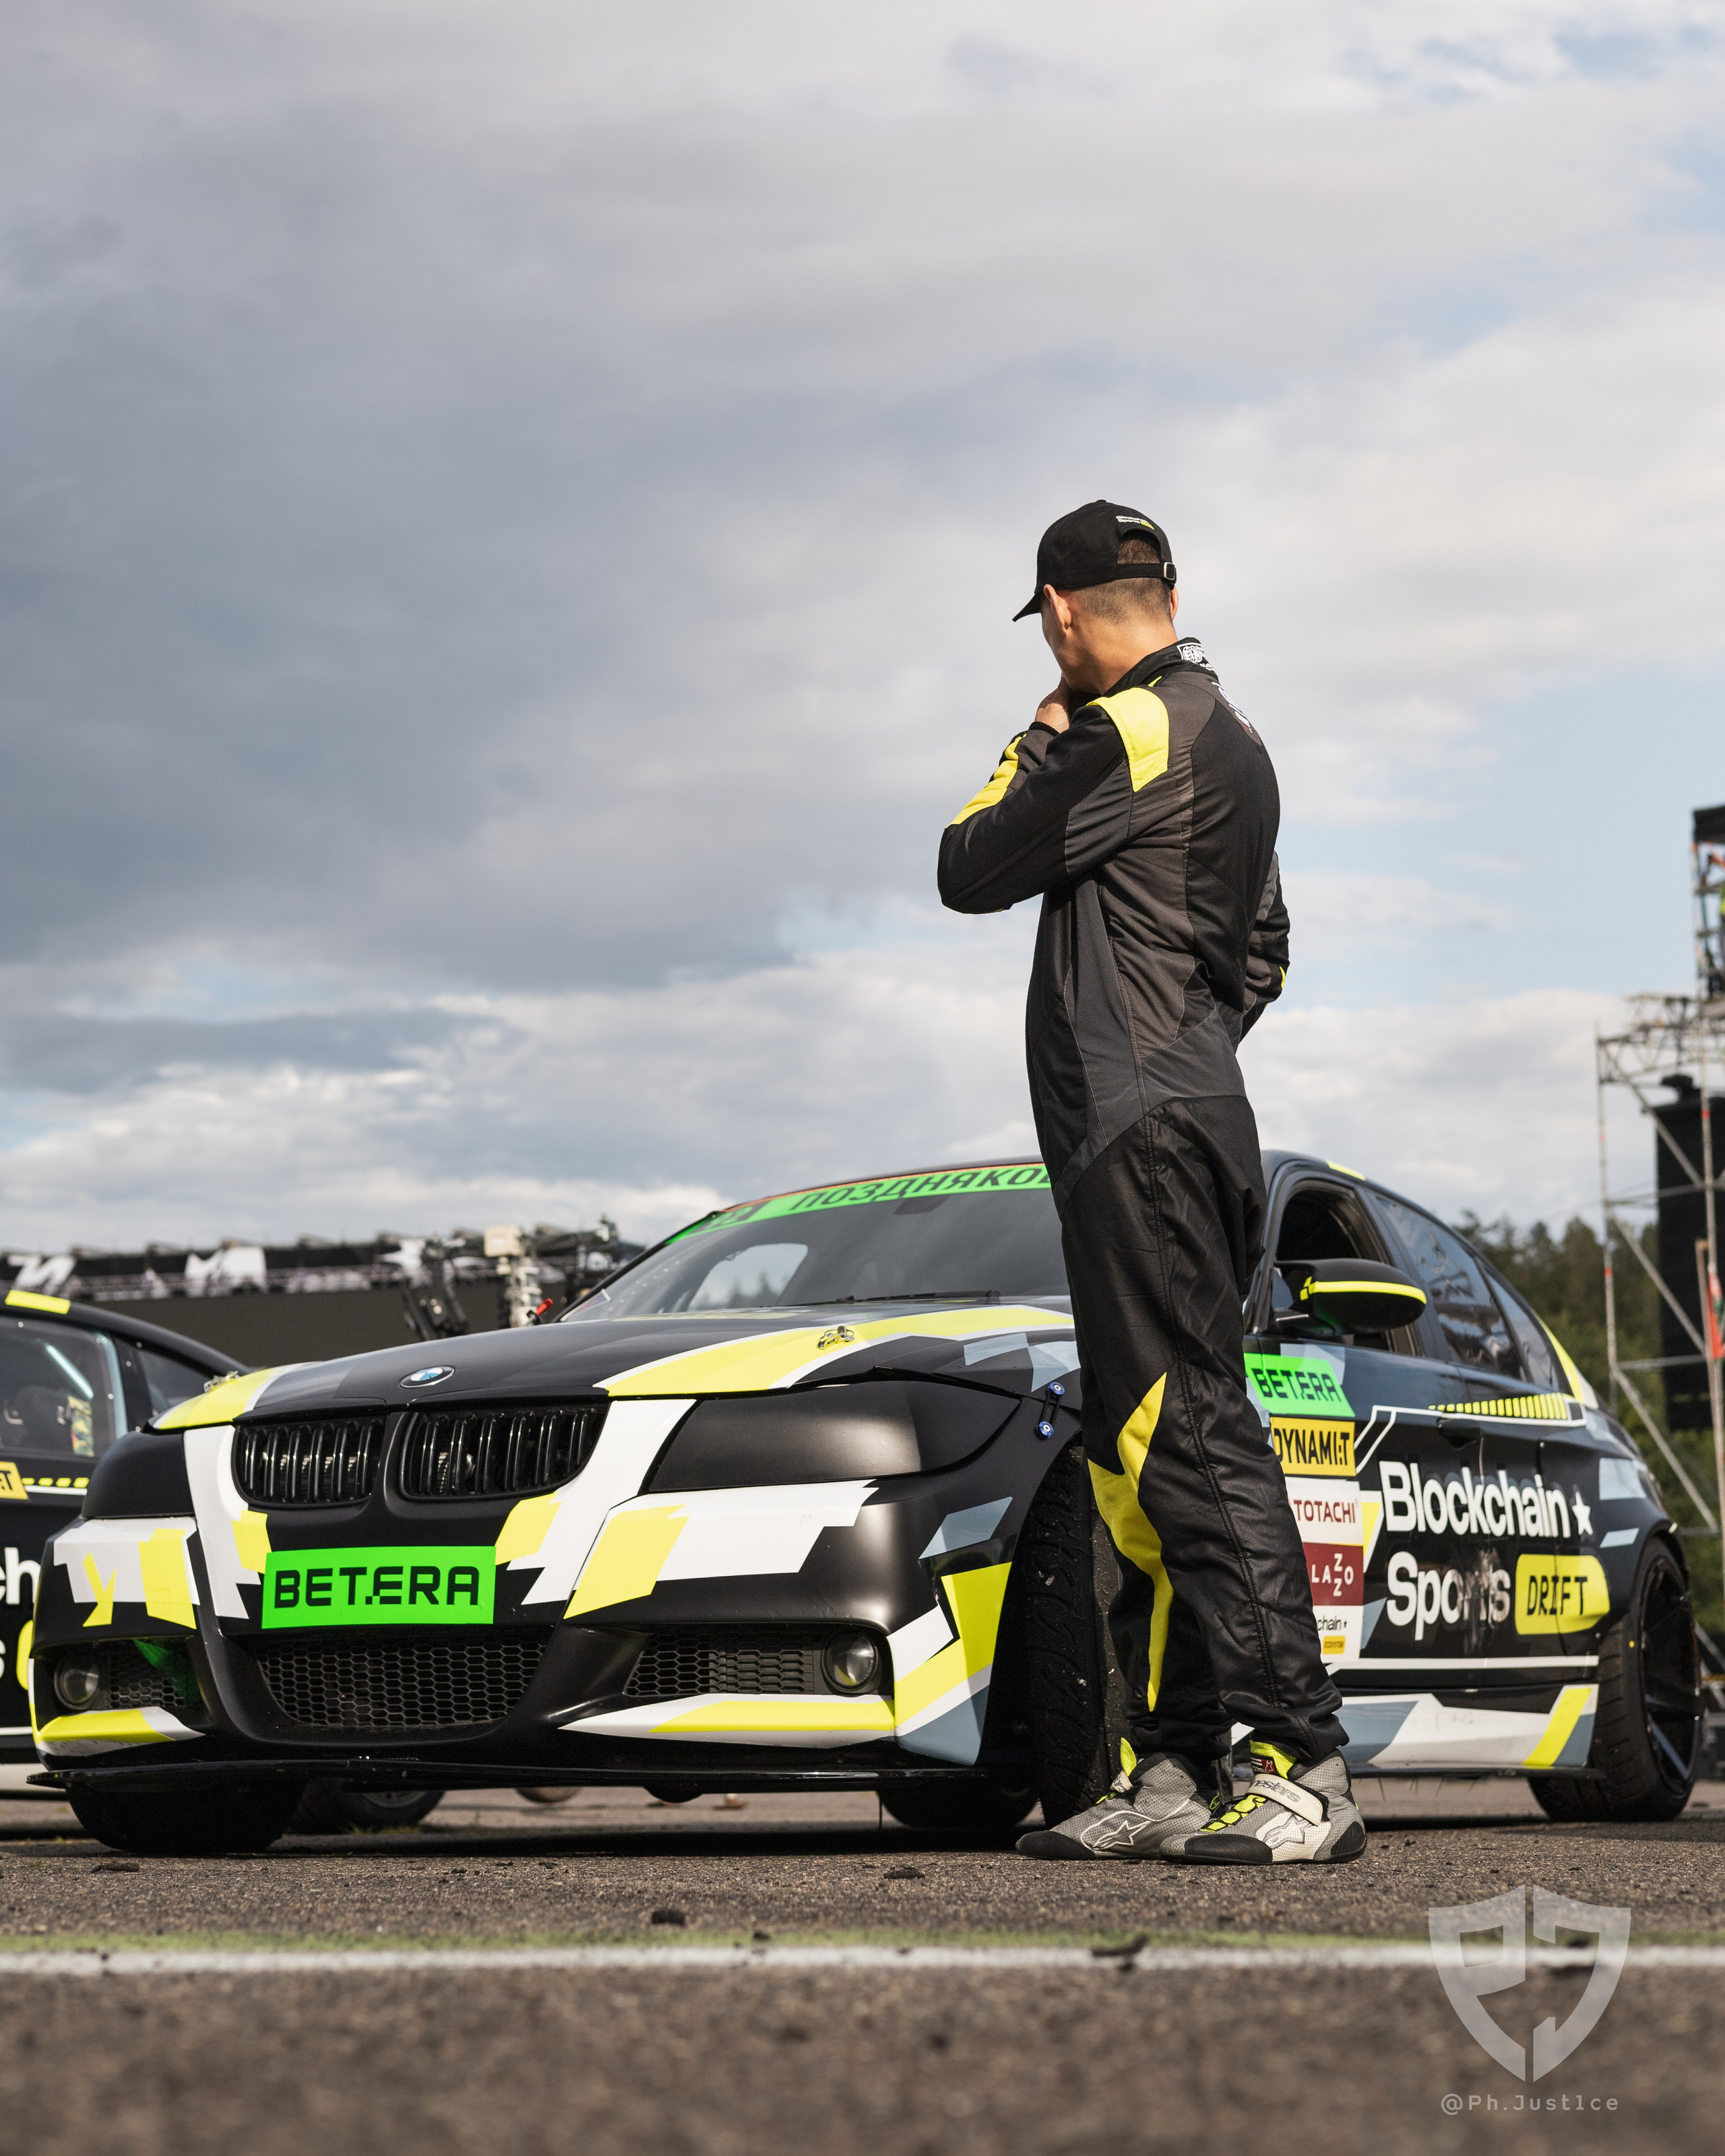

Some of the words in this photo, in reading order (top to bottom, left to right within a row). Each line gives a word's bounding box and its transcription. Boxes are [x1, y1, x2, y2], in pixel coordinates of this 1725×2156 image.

[1293, 1500, 1356, 1524] TOTACHI
[1379, 1461, 1571, 1539] Blockchain
[1526, 1575, 1588, 1616] DRIFT
[1317, 1615, 1342, 1631] chain
